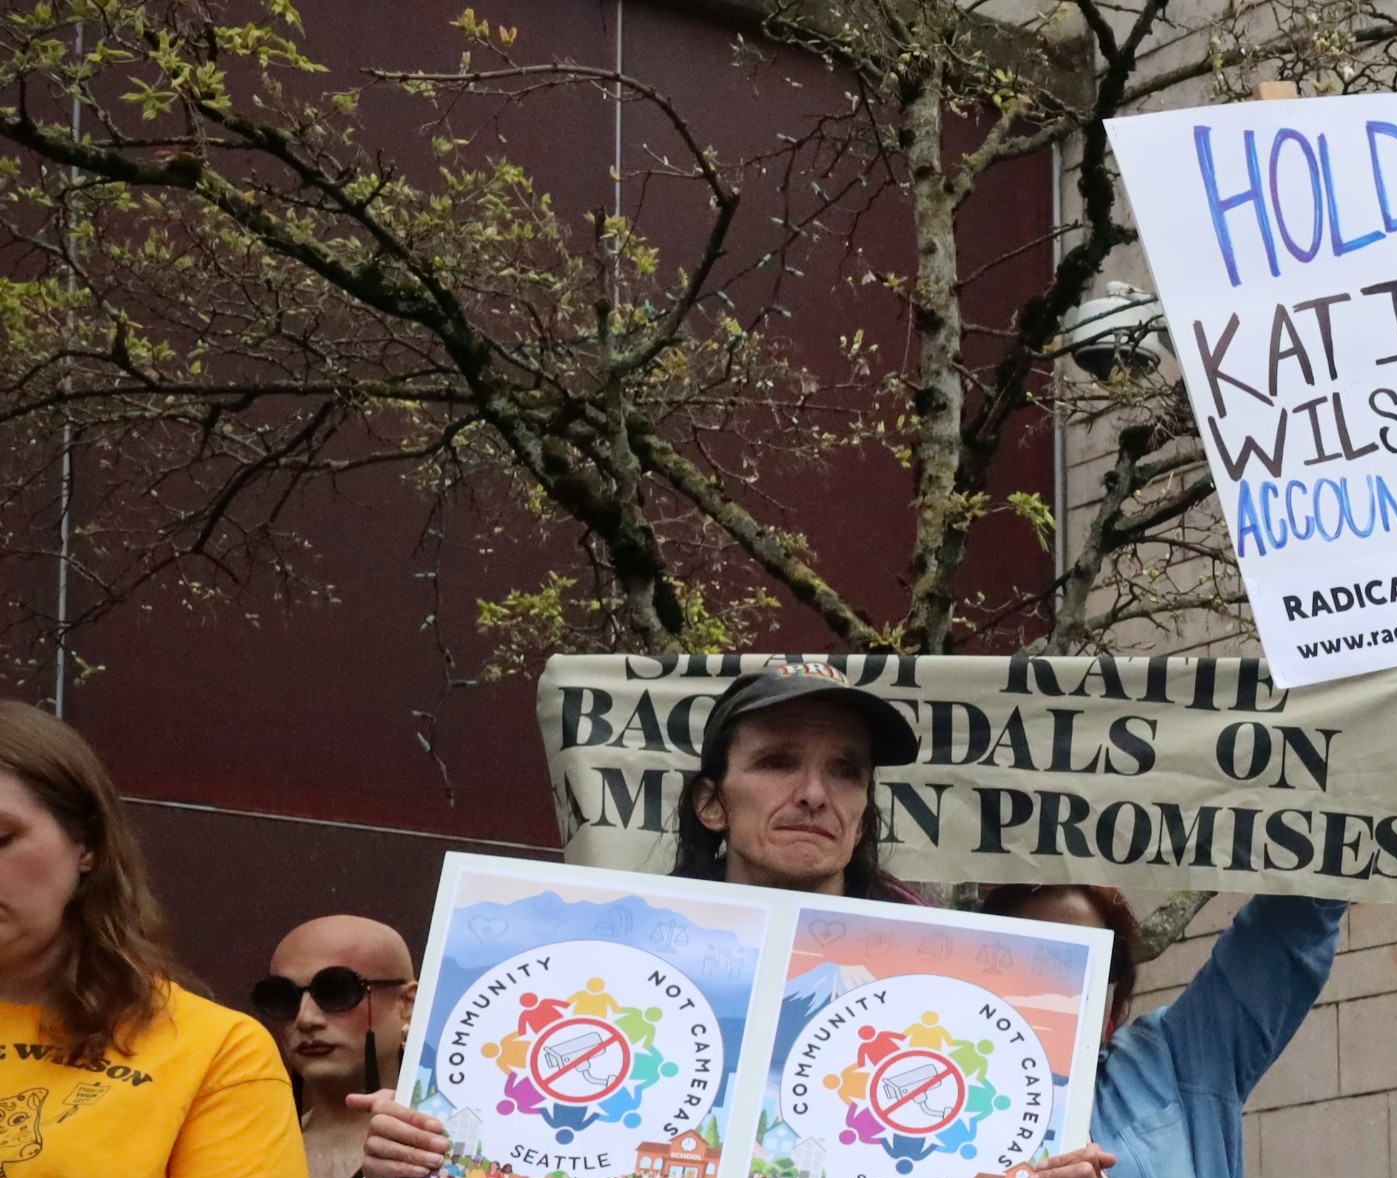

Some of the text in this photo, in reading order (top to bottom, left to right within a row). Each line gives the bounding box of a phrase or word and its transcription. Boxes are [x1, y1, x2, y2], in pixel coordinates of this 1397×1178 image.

[1216, 721, 1342, 793] ON
[448, 956, 711, 1136] COMMUNITY NOT CAMERAS
[792, 990, 1042, 1169] COMMUNITY NOT CAMERAS
[510, 1144, 612, 1170] SEATTLE
[670, 1151, 704, 1161] SCHOOL
